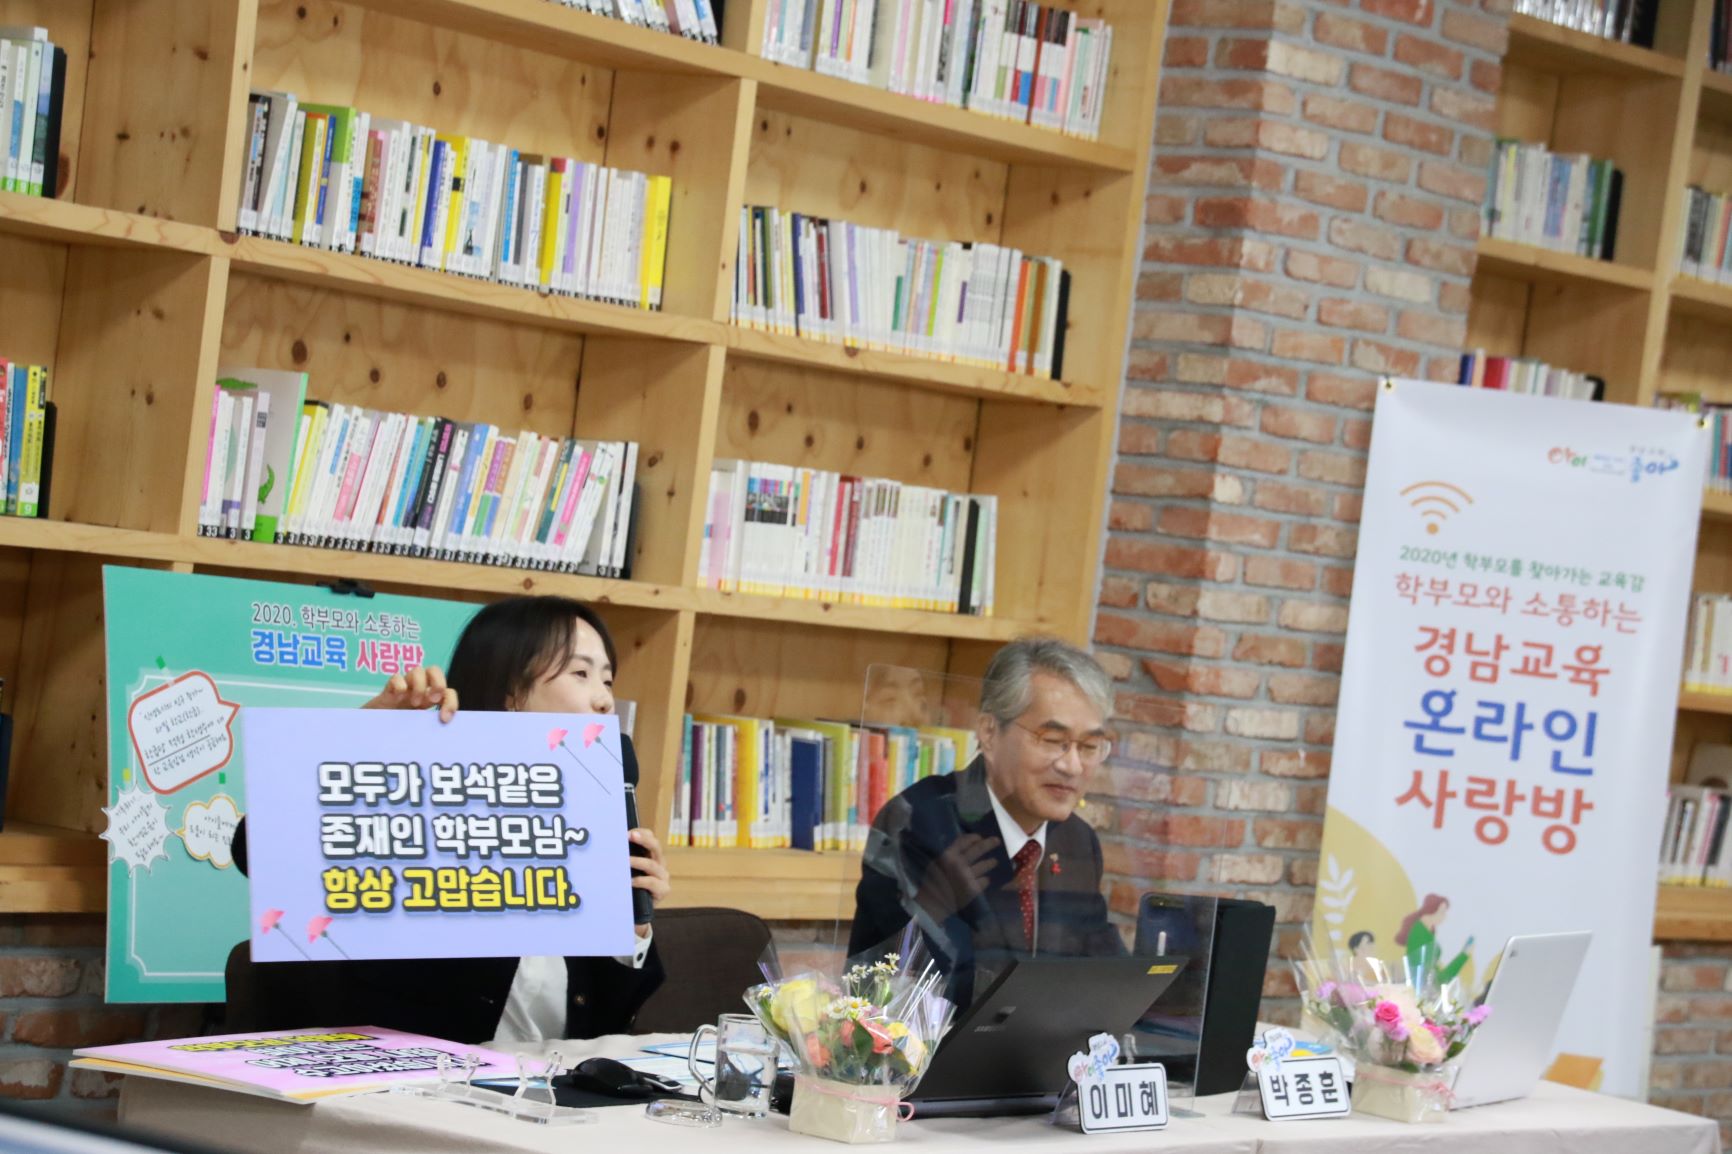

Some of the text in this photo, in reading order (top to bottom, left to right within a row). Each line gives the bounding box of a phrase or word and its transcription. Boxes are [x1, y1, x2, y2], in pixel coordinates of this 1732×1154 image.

[1400, 546, 1646, 592] 2020년 학부모를 찾아가는 교육감
[253, 603, 420, 640] 2020. 학부모와 소통하는
[1396, 573, 1643, 634] 학부모와 소통하는
[252, 630, 346, 669] 경남교육
[1414, 626, 1611, 697] 경남교육
[1403, 689, 1597, 776] 온라인
[319, 762, 563, 807] 모두가 보석같은
[1395, 770, 1594, 855] 사랑방
[321, 814, 587, 859] 존재인 학부모님~
[322, 866, 579, 911] 항상 고맙습니다.
[1090, 1080, 1160, 1119] 이미혜
[1269, 1070, 1339, 1106] 박종훈
